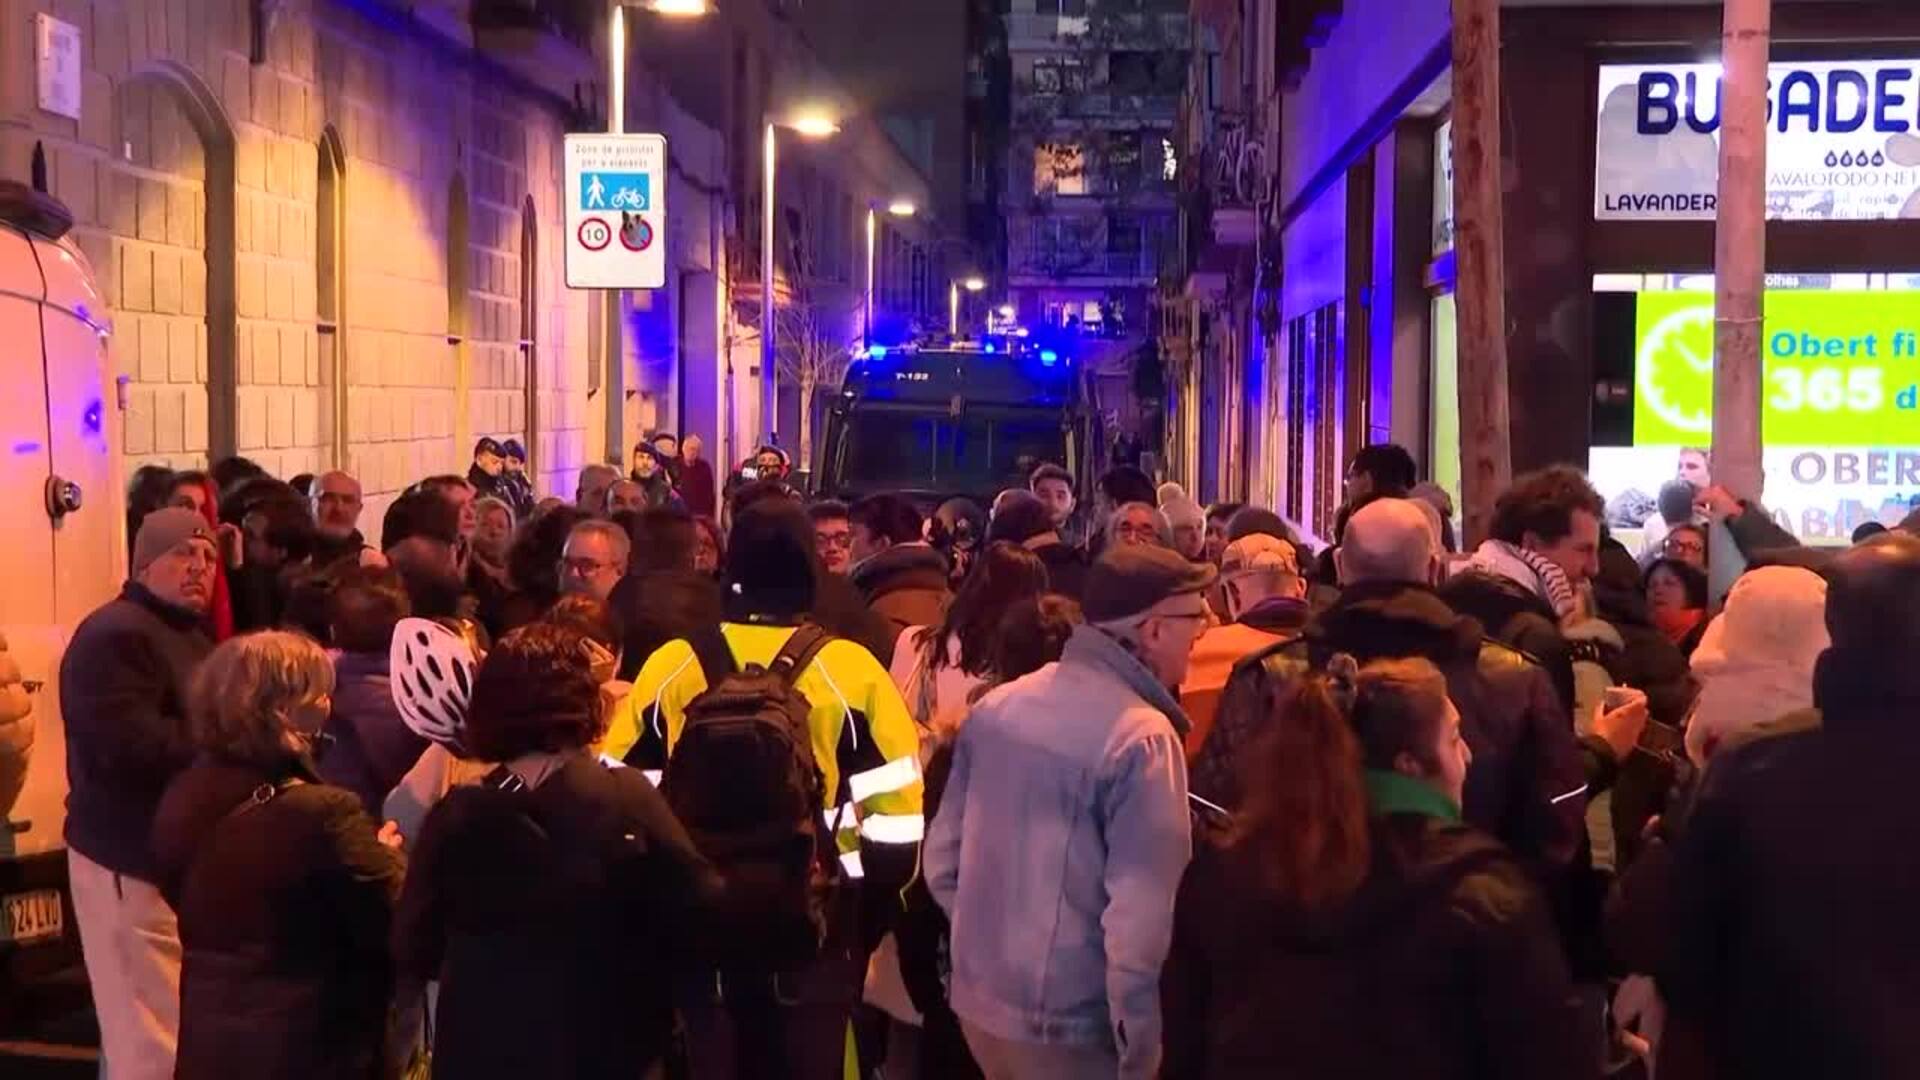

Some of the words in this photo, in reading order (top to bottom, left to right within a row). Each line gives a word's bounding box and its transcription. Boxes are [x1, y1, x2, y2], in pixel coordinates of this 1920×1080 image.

[1637, 68, 1920, 134] BUADE
[586, 228, 605, 242] 10
[1771, 332, 1878, 357] Obert
[1893, 332, 1916, 357] fi
[1769, 366, 1885, 412] 365
[1895, 383, 1917, 409] d
[1790, 451, 1920, 485] OBER
